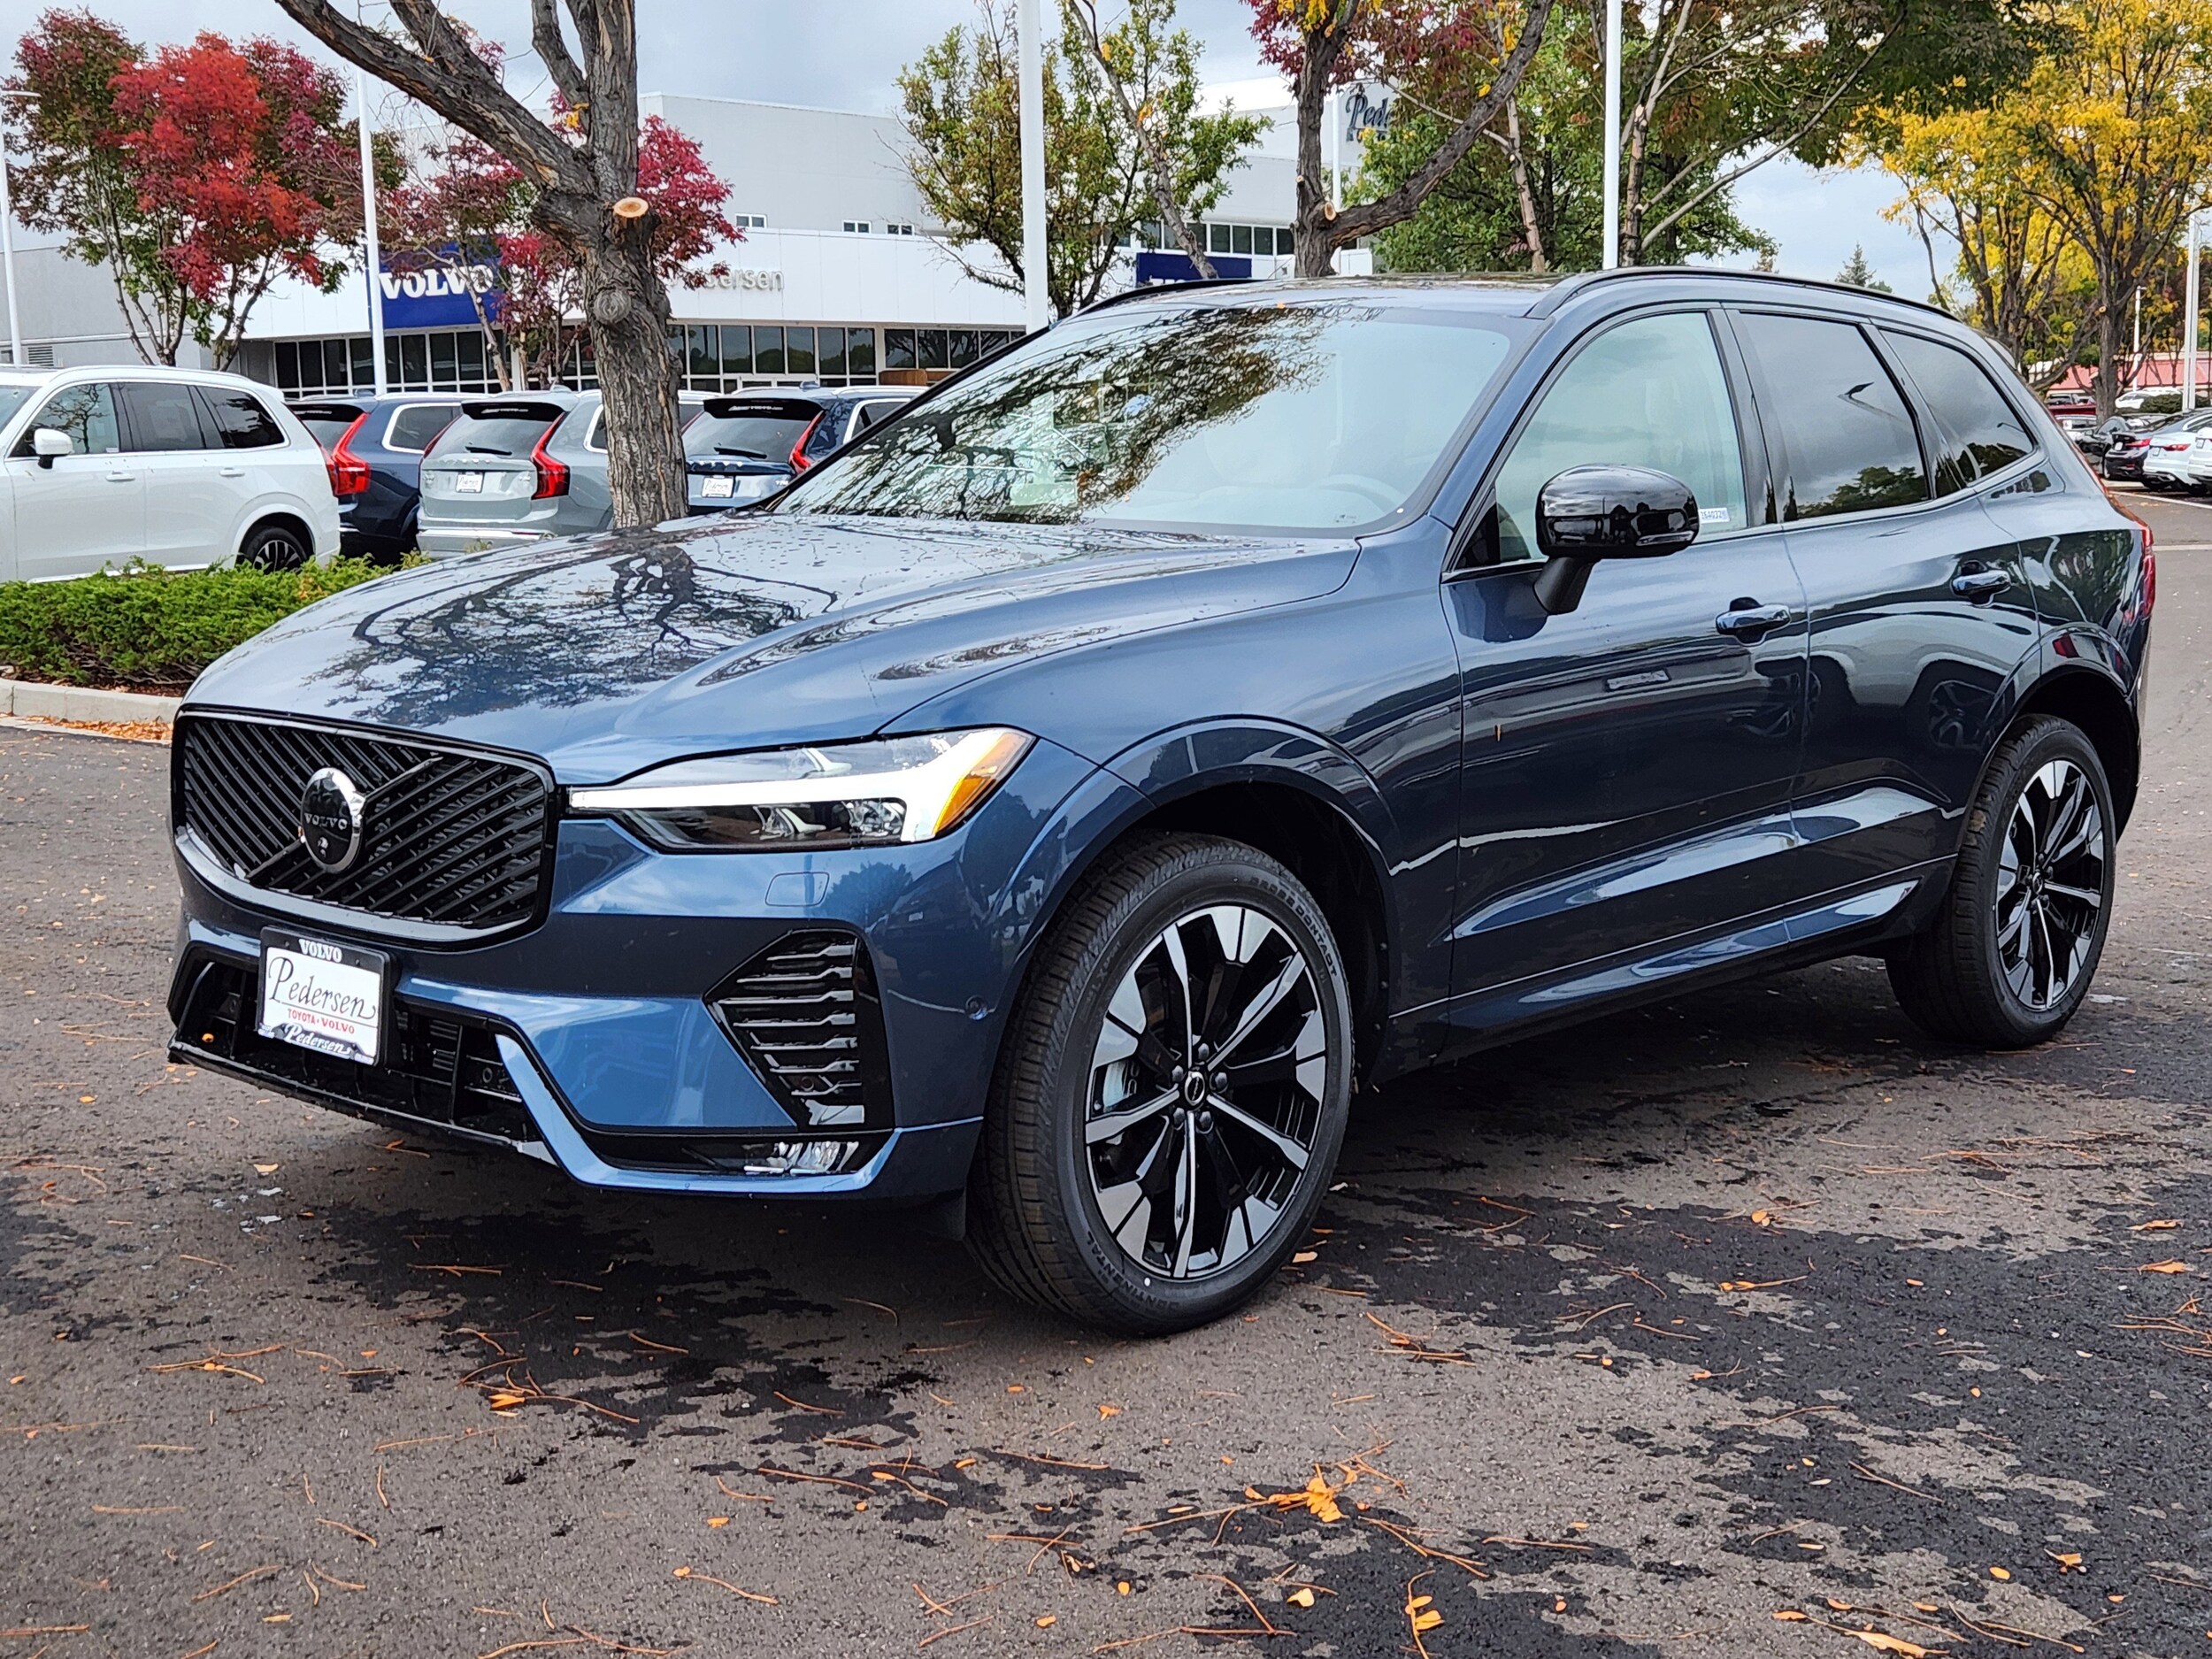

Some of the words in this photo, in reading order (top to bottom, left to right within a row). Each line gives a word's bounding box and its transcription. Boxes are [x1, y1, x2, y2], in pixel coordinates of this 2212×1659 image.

[379, 265, 494, 300] VOLVO
[303, 812, 348, 831] VOLVO
[298, 938, 343, 964] VOLVO
[268, 956, 377, 1020] Pedersen
[287, 1008, 316, 1025] TOYOTA
[321, 1017, 356, 1034] VOLVO
[283, 1022, 352, 1056] Pedersen
